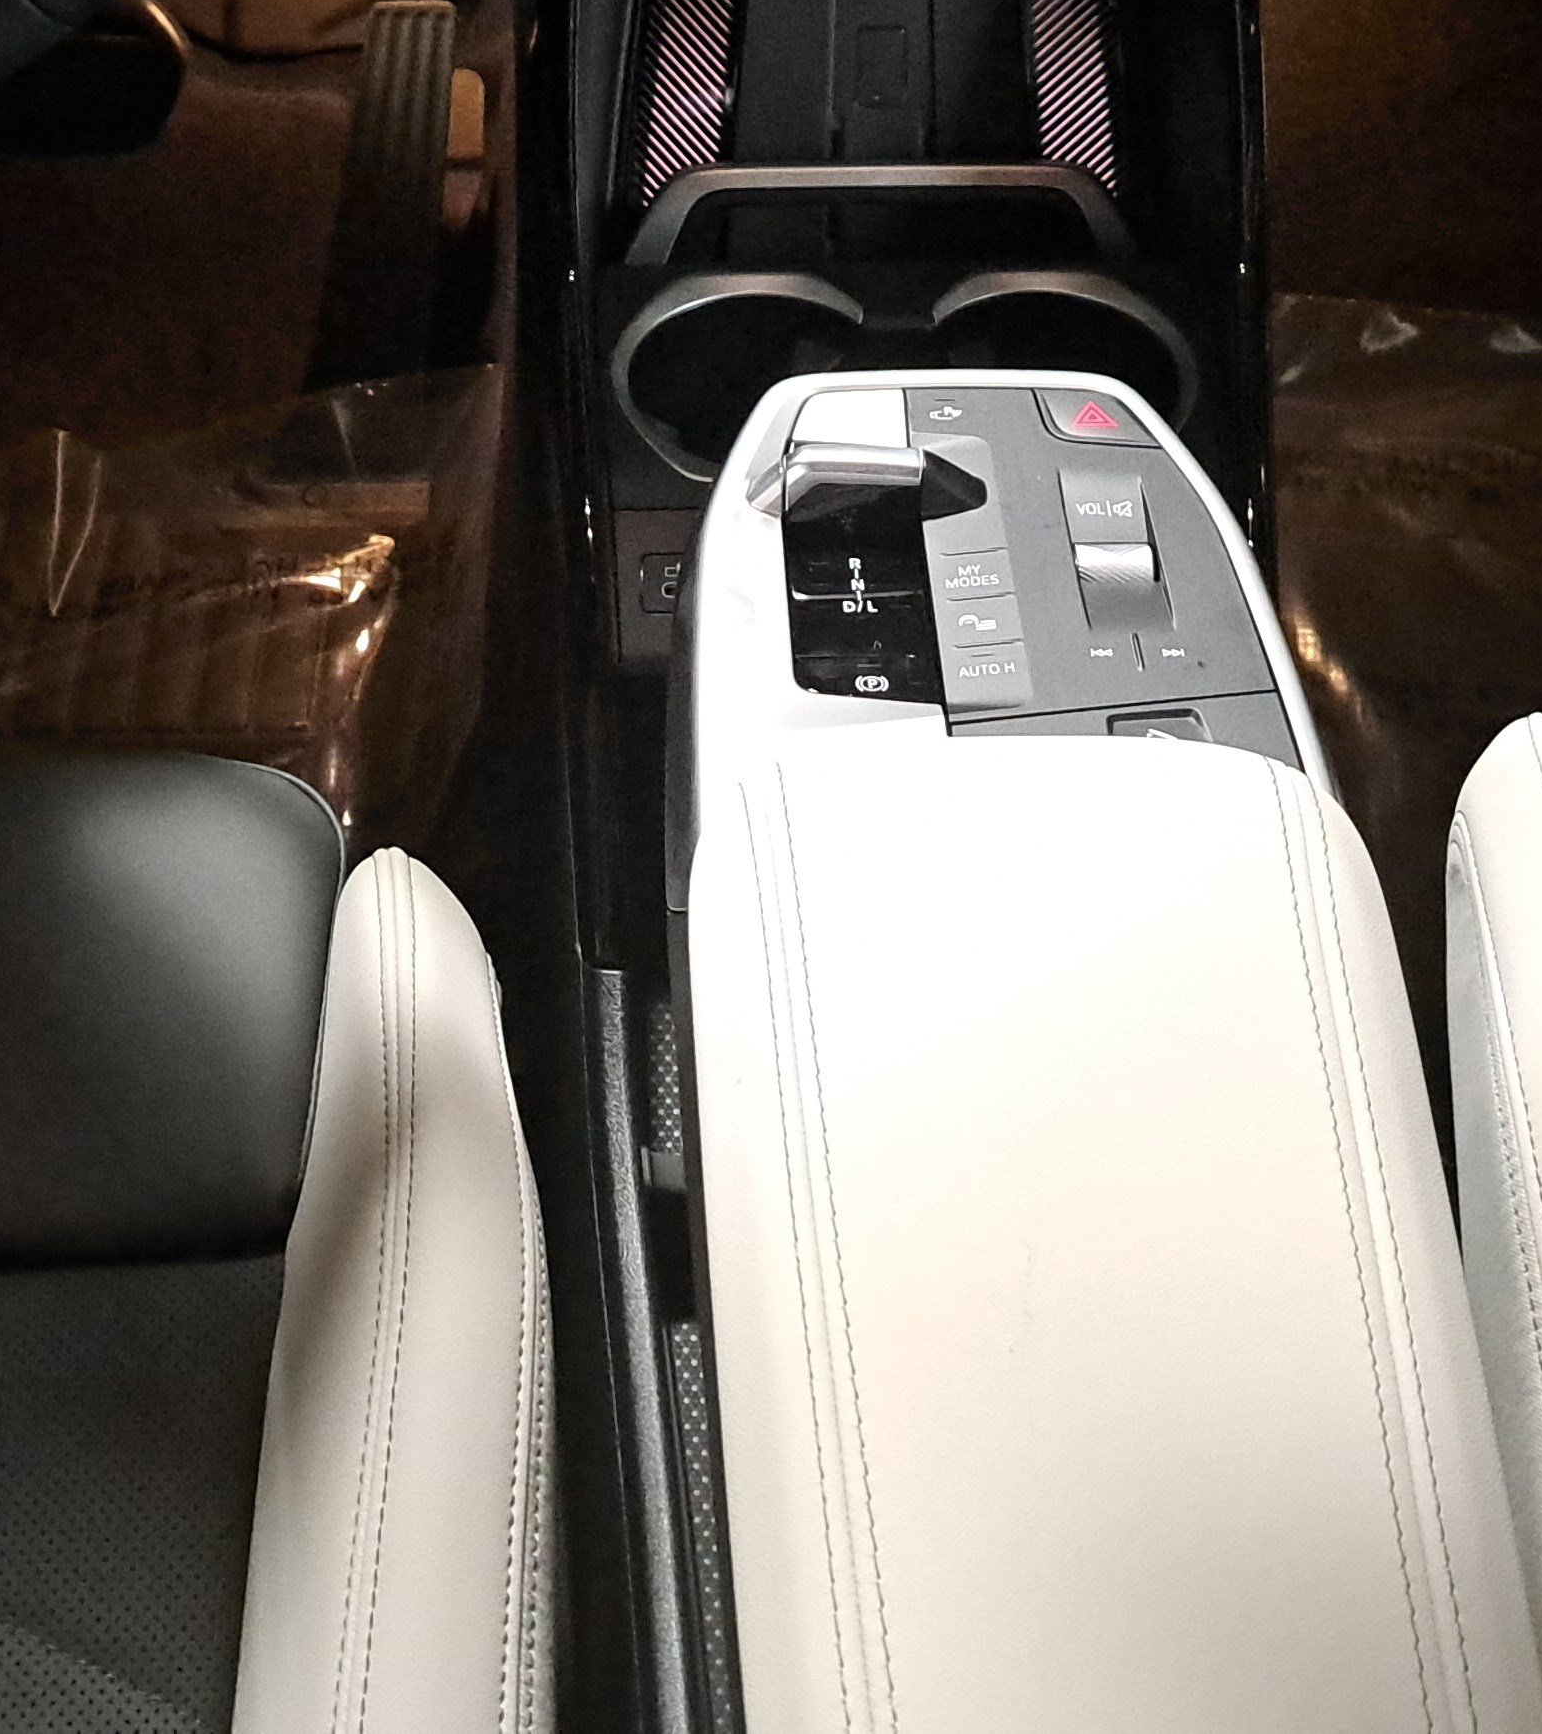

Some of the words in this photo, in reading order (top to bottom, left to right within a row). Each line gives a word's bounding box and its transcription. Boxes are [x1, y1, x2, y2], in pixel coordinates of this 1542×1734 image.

[1075, 502, 1105, 515] VOL
[848, 557, 861, 569] R
[957, 564, 980, 576] MY
[850, 578, 865, 591] N
[945, 573, 1000, 589] MODES
[959, 663, 1000, 677] AUTO
[1004, 661, 1016, 674] H
